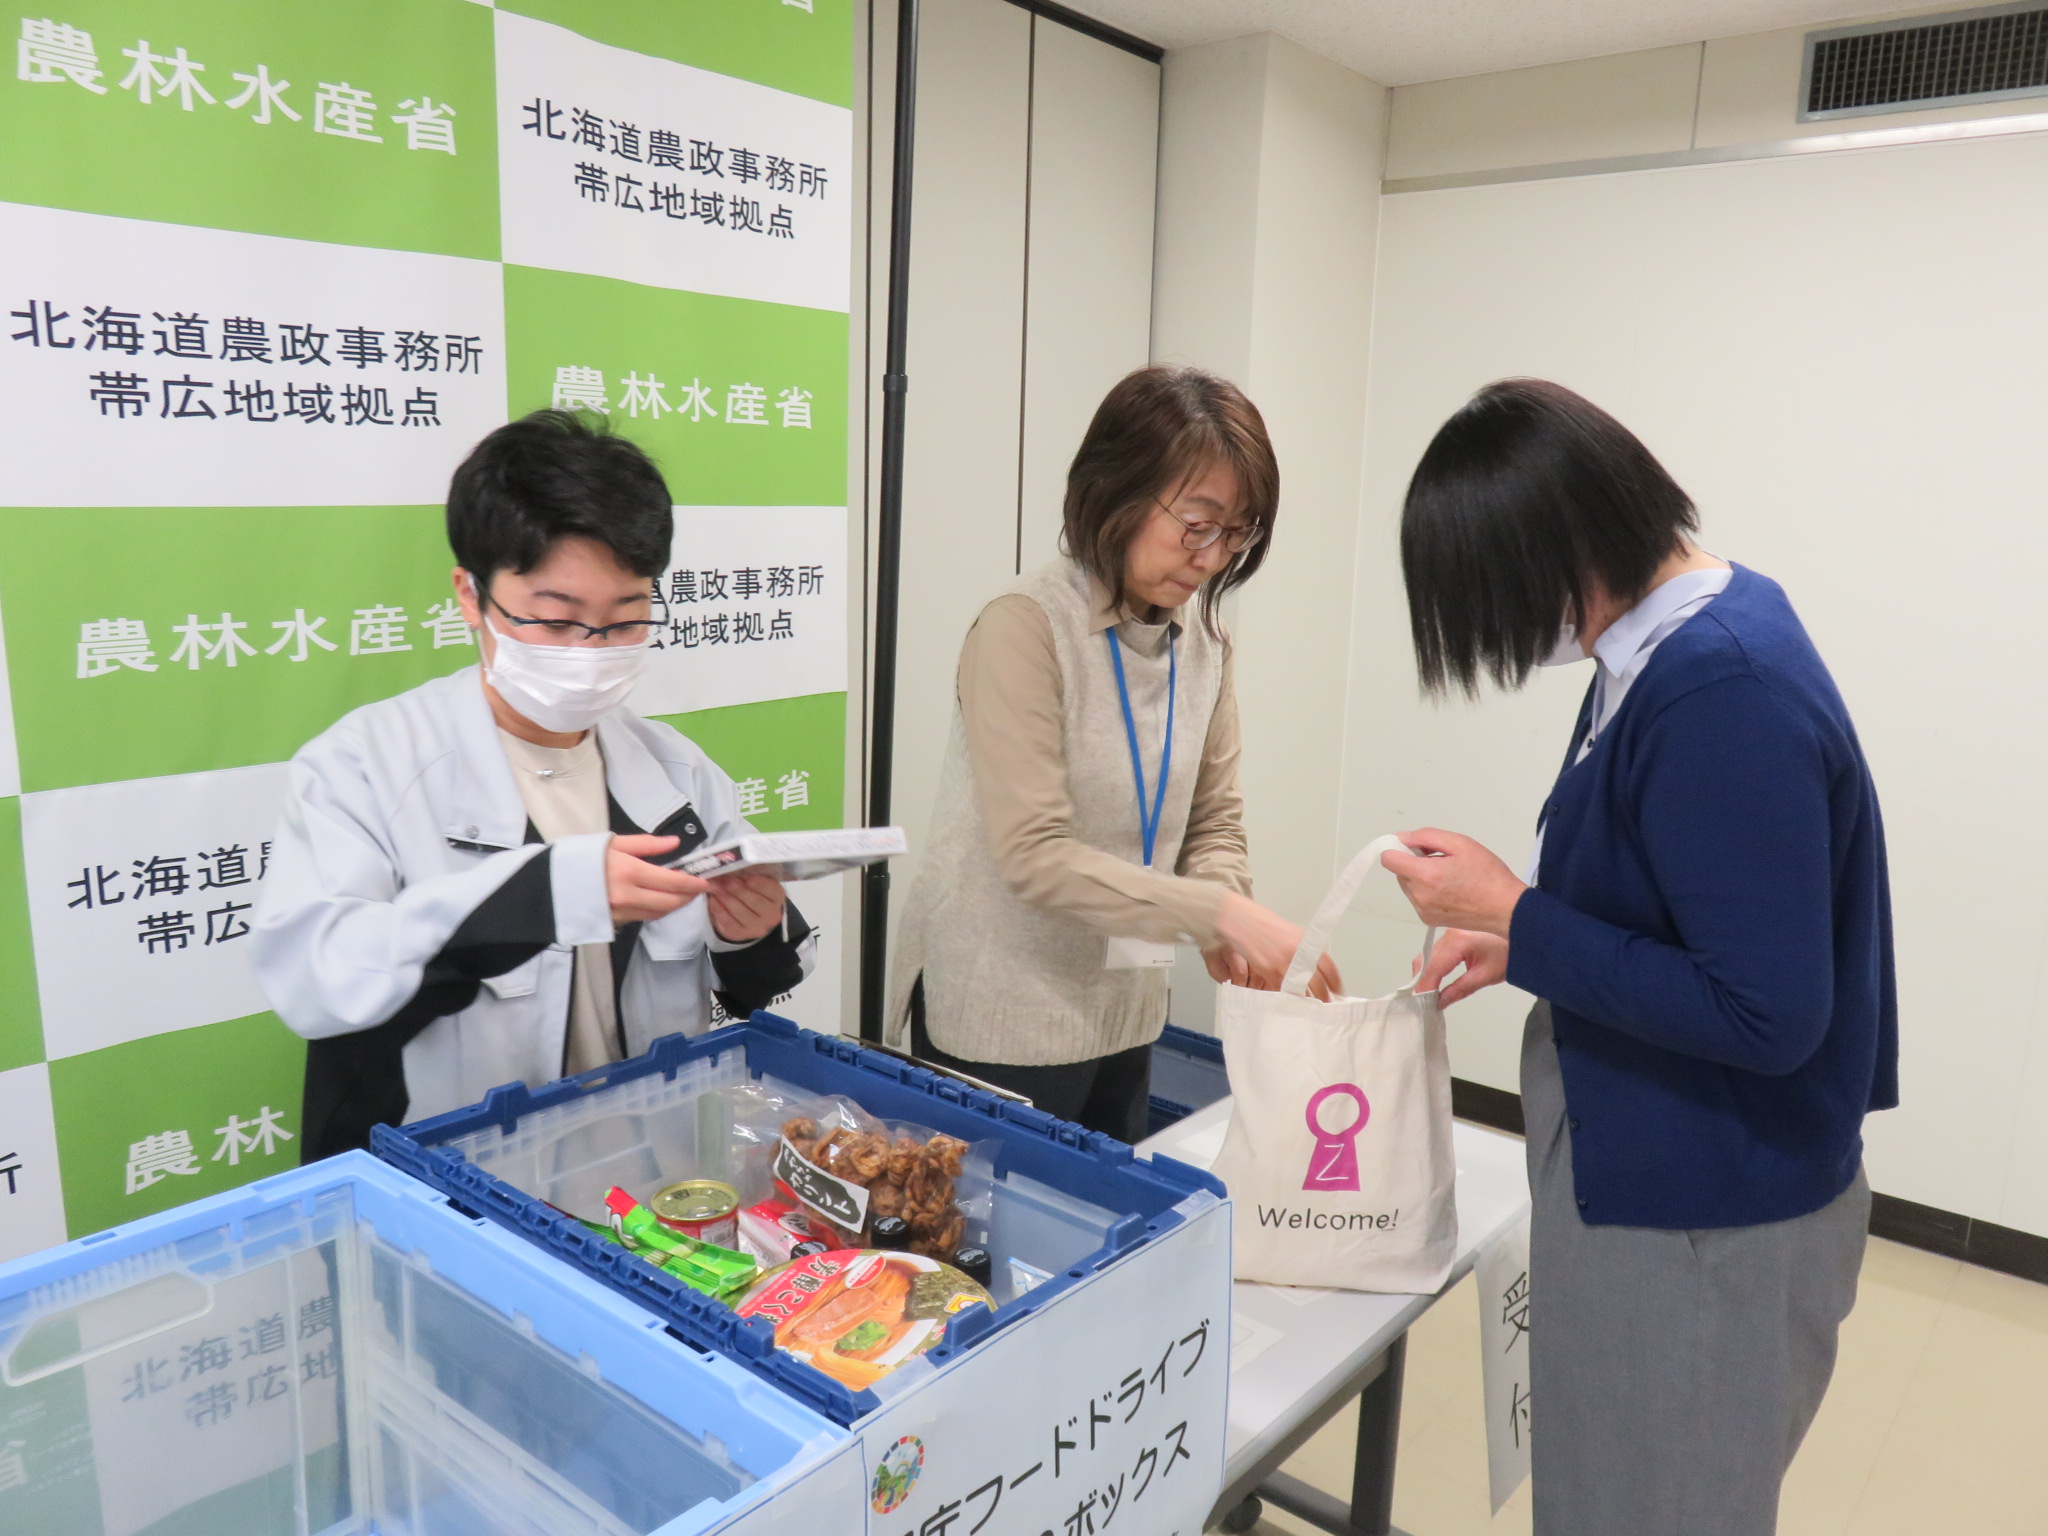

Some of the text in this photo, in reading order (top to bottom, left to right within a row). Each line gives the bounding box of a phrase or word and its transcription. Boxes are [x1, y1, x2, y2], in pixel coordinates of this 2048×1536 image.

[17, 17, 457, 156] 農林水産省
[522, 97, 828, 200] 北海道農政事務所
[574, 161, 795, 239] 帯広地域拠点
[10, 299, 484, 374] 北海道農政事務所
[89, 370, 442, 427] 帯広地域拠点
[552, 365, 813, 429] 農林水産省
[76, 598, 474, 679] 農林水産省
[125, 1106, 295, 1195] 農林
[1257, 1204, 1399, 1231] Welcome!
